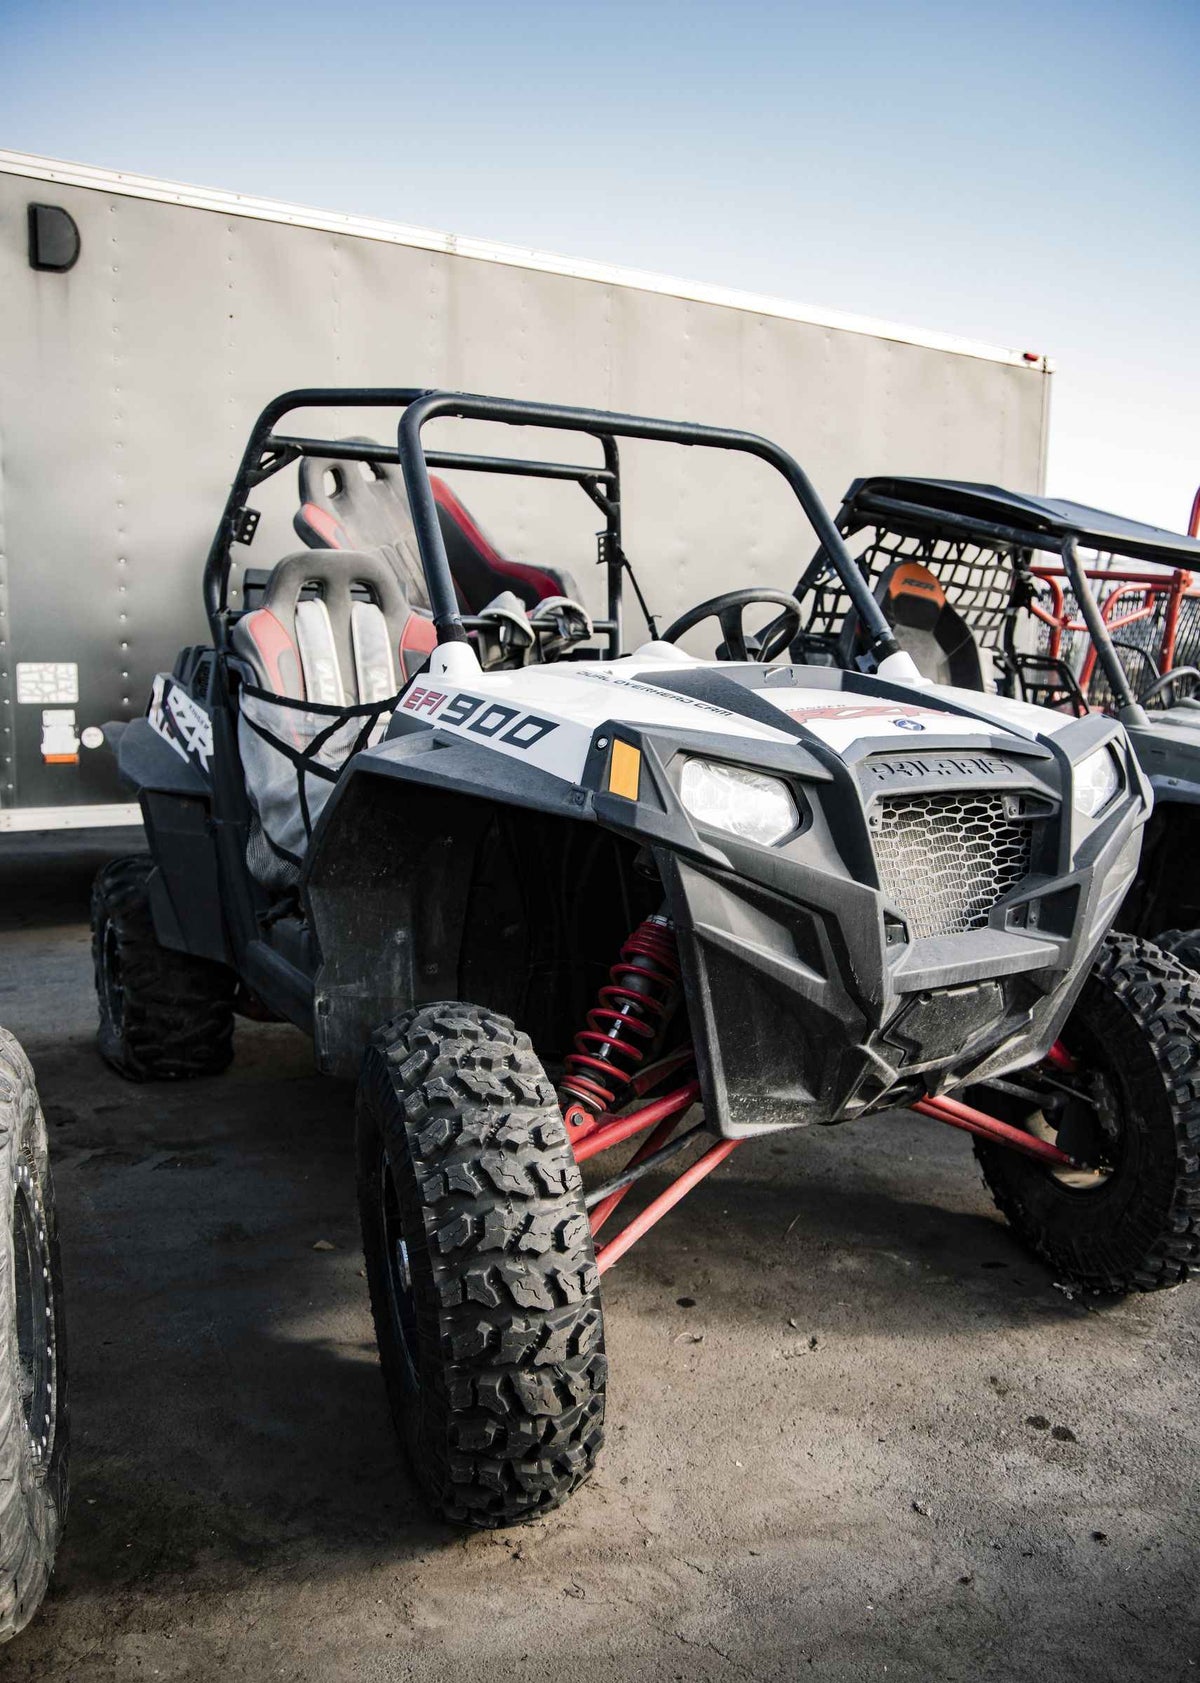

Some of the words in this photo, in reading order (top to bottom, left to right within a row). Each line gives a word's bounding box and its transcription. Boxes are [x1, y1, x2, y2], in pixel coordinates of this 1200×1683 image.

[576, 671, 611, 682] DUAL
[613, 679, 694, 704] OVERHEAD
[693, 702, 734, 717] CAM
[403, 687, 448, 715] EFI
[437, 693, 560, 750] 900
[866, 757, 1014, 781] POLARIS
